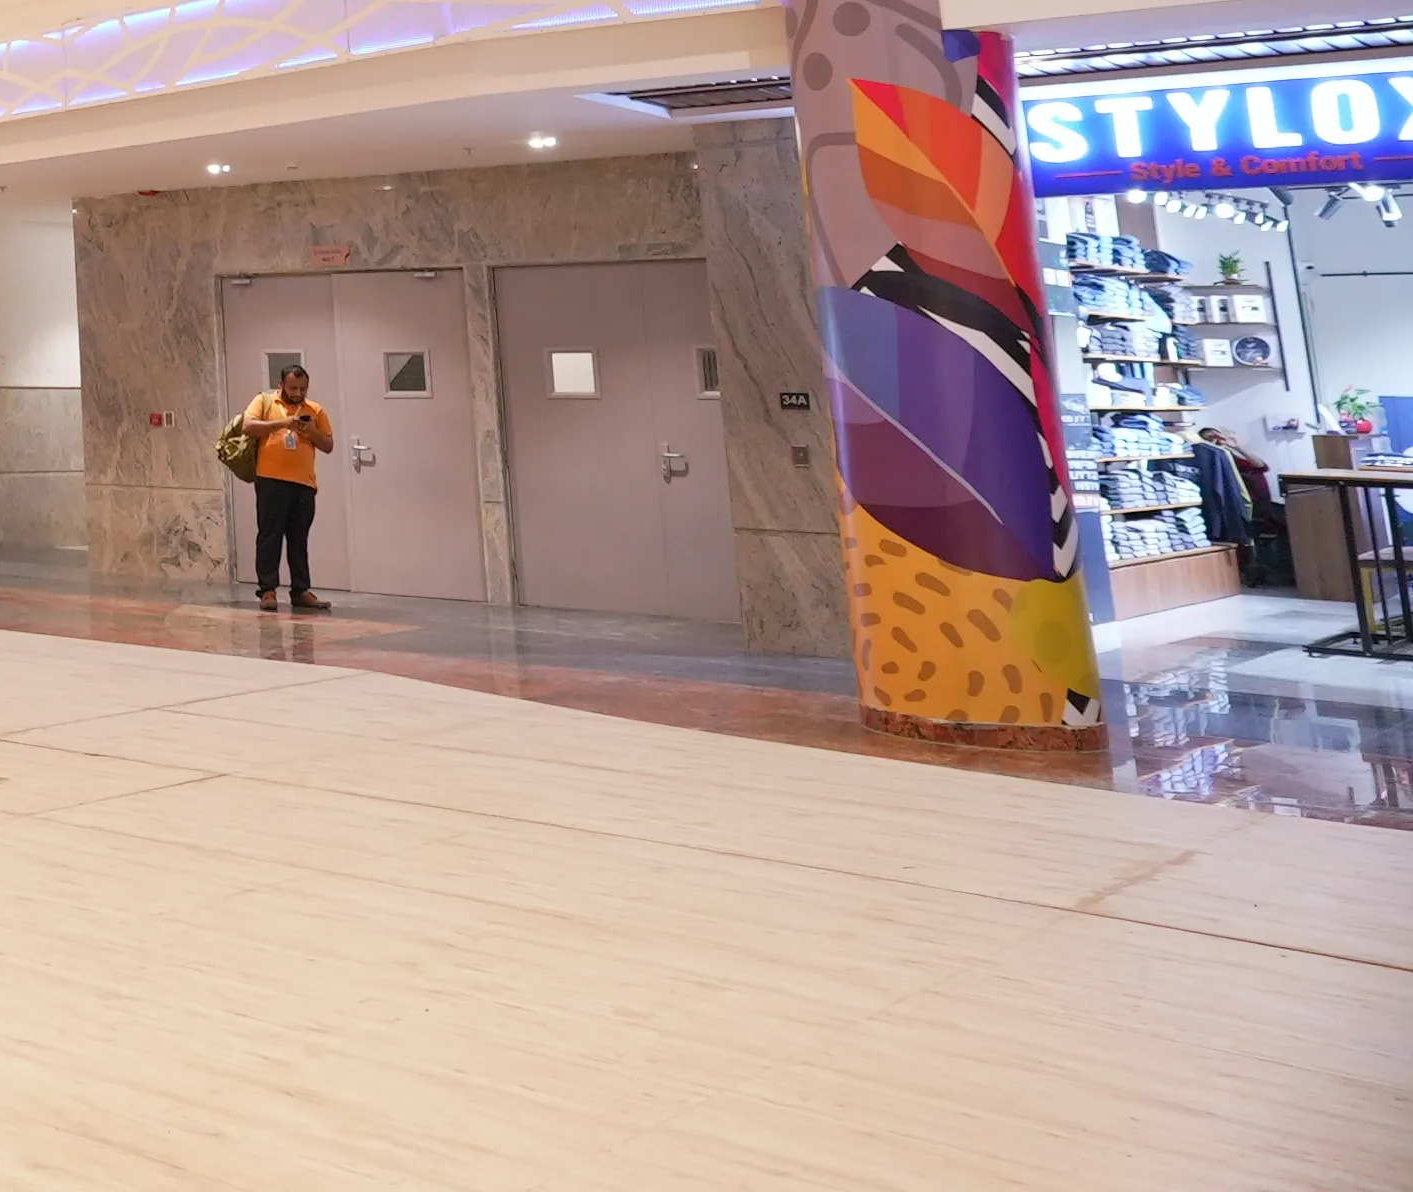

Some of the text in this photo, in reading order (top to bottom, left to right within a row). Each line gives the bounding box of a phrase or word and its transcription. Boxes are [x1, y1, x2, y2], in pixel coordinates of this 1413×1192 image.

[1130, 150, 1366, 185] Style & Comfort
[781, 394, 808, 406] 34A
